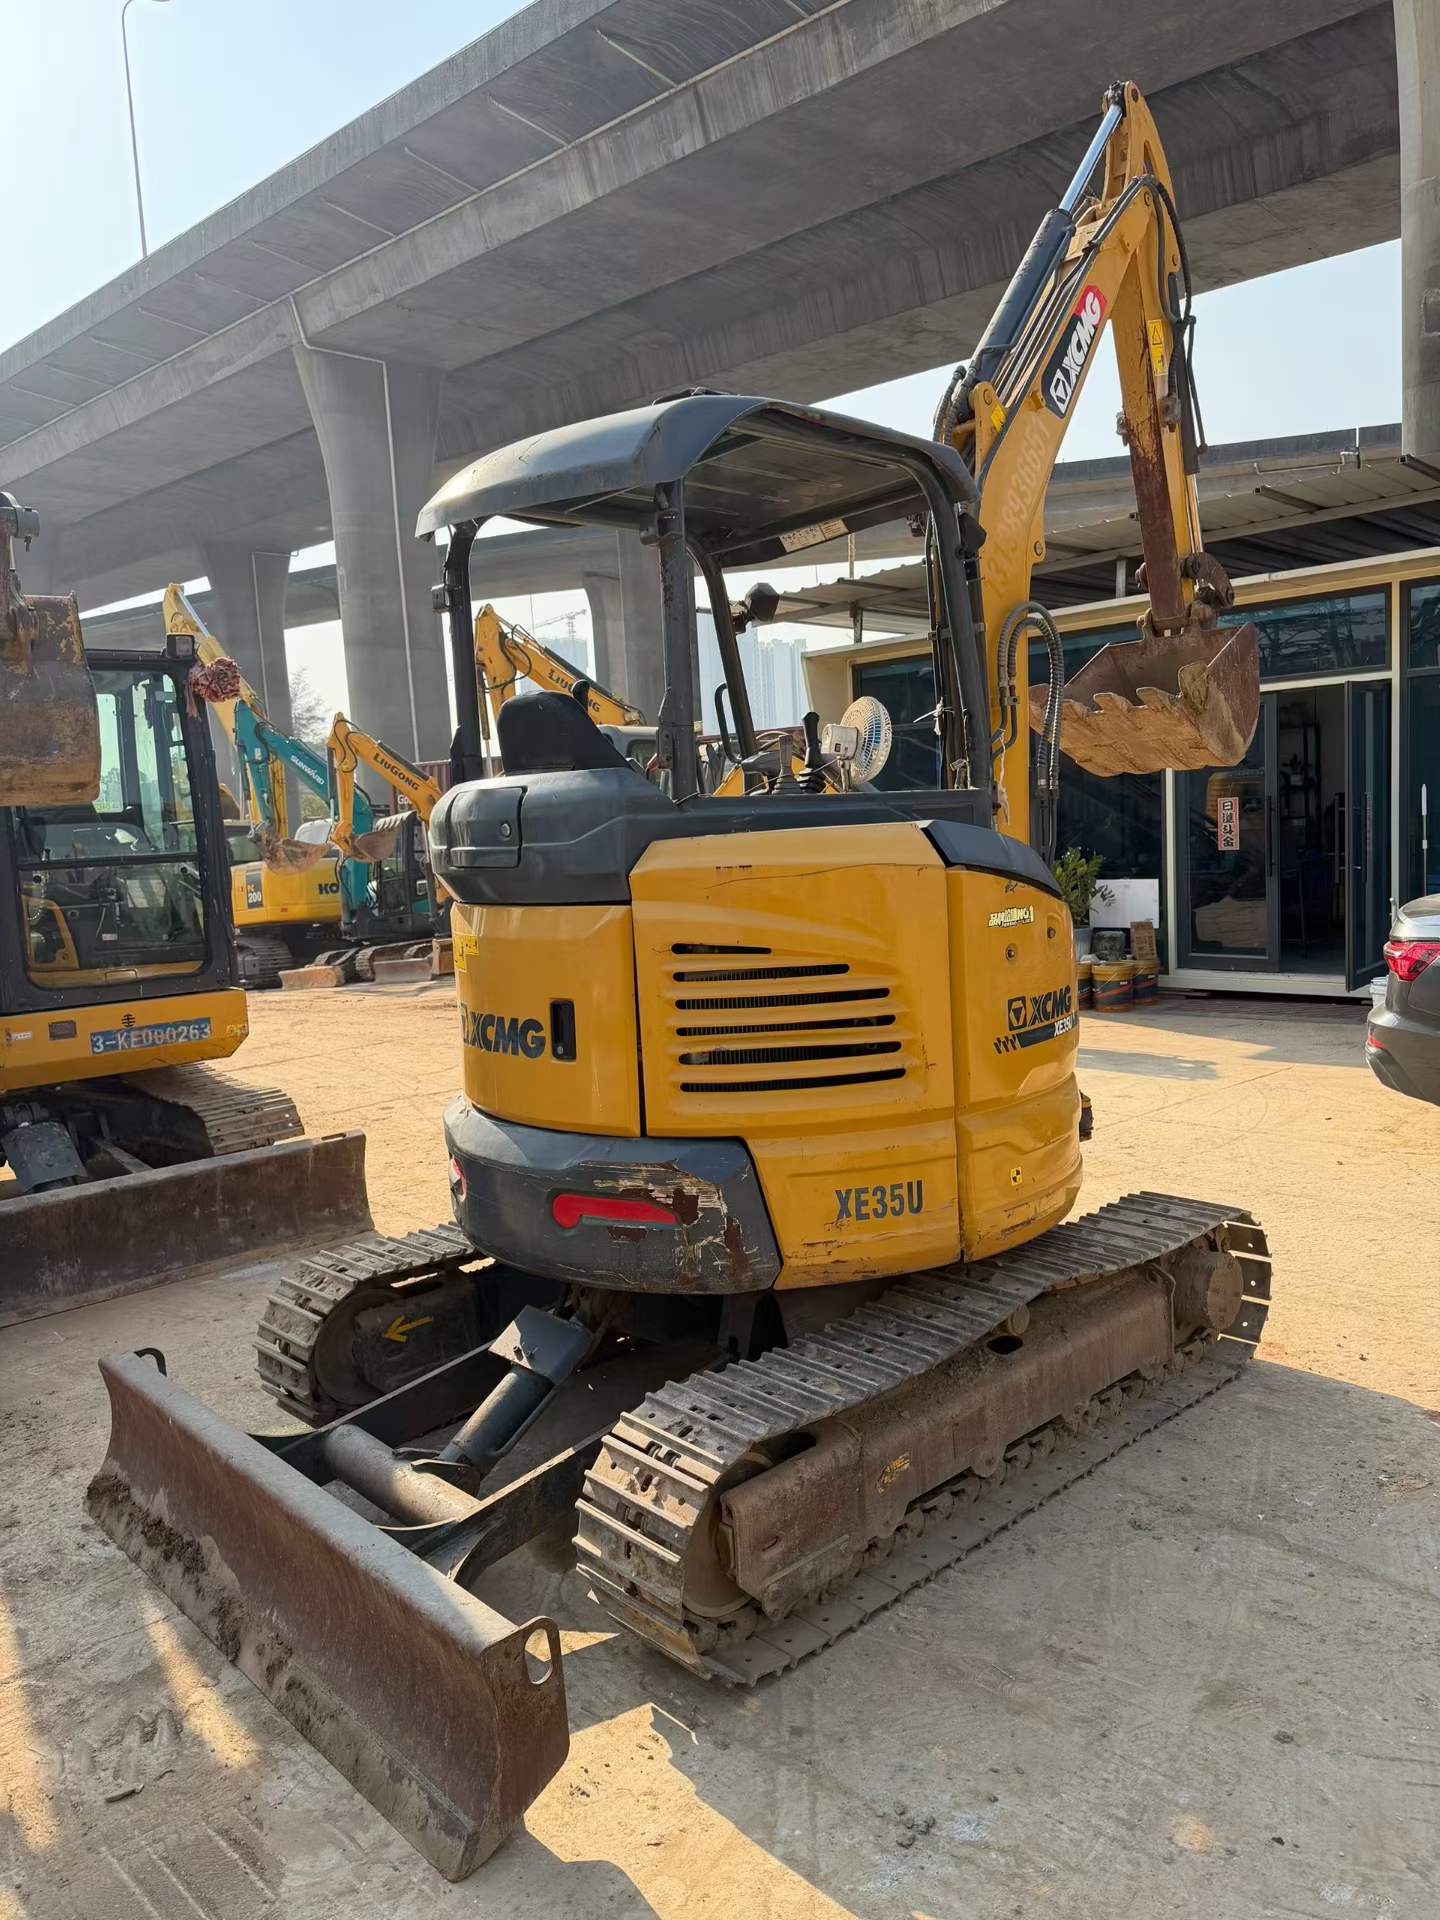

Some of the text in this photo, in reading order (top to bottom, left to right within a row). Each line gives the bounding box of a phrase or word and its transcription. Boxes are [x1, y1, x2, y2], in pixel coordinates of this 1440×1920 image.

[1062, 292, 1101, 391] XCMG
[547, 669, 601, 713] LIUG
[290, 755, 325, 785] SUNWARD
[373, 753, 420, 791] LIUGONG
[248, 890, 262, 904] 200
[318, 882, 340, 895] KO
[1028, 985, 1072, 1027] XCMG
[470, 1011, 547, 1059] XCMG
[834, 1179, 923, 1221] XE35U
